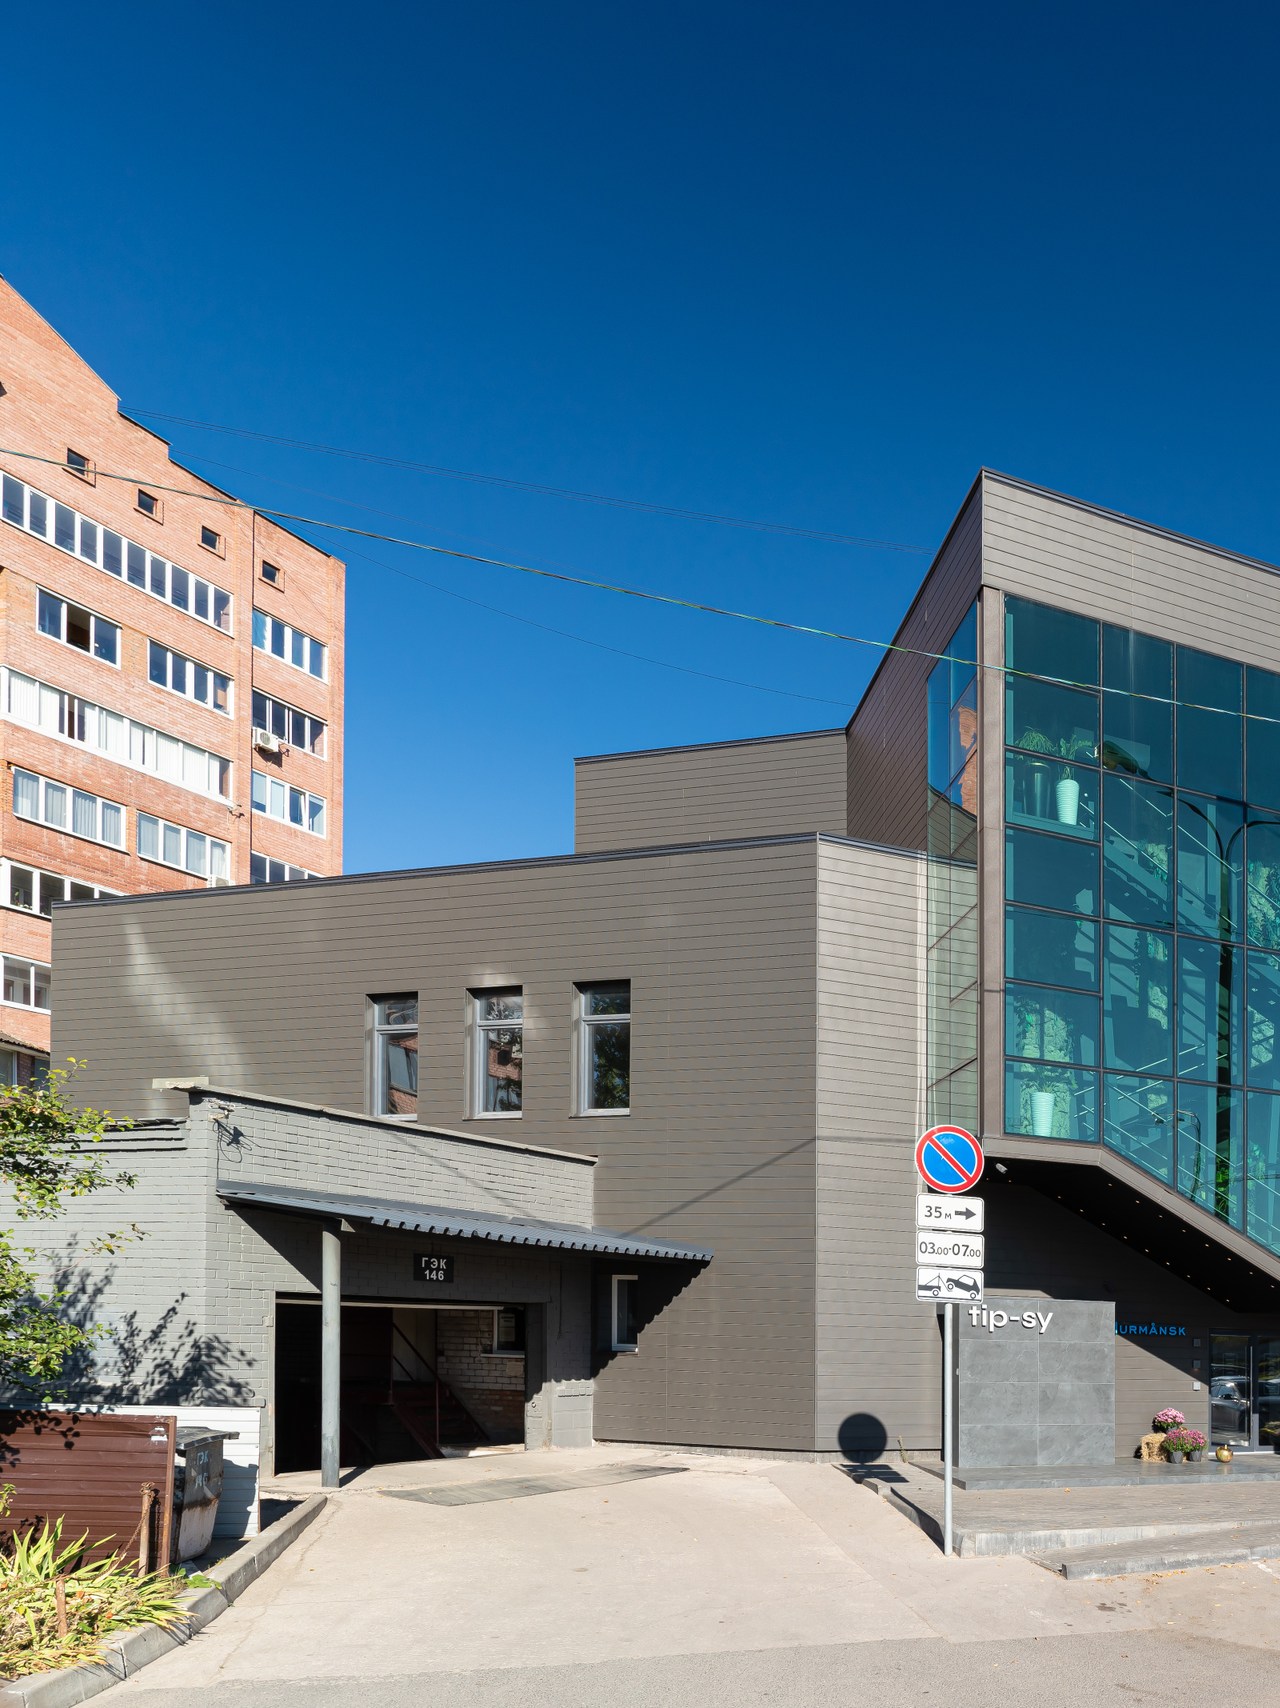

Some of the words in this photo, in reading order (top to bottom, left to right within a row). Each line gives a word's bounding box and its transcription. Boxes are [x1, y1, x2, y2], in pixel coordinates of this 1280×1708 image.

[421, 1256, 447, 1269] ГЭК
[424, 1269, 444, 1280] 146
[968, 1304, 1053, 1334] tip-sy
[1115, 1322, 1186, 1336] URMÅNSK
